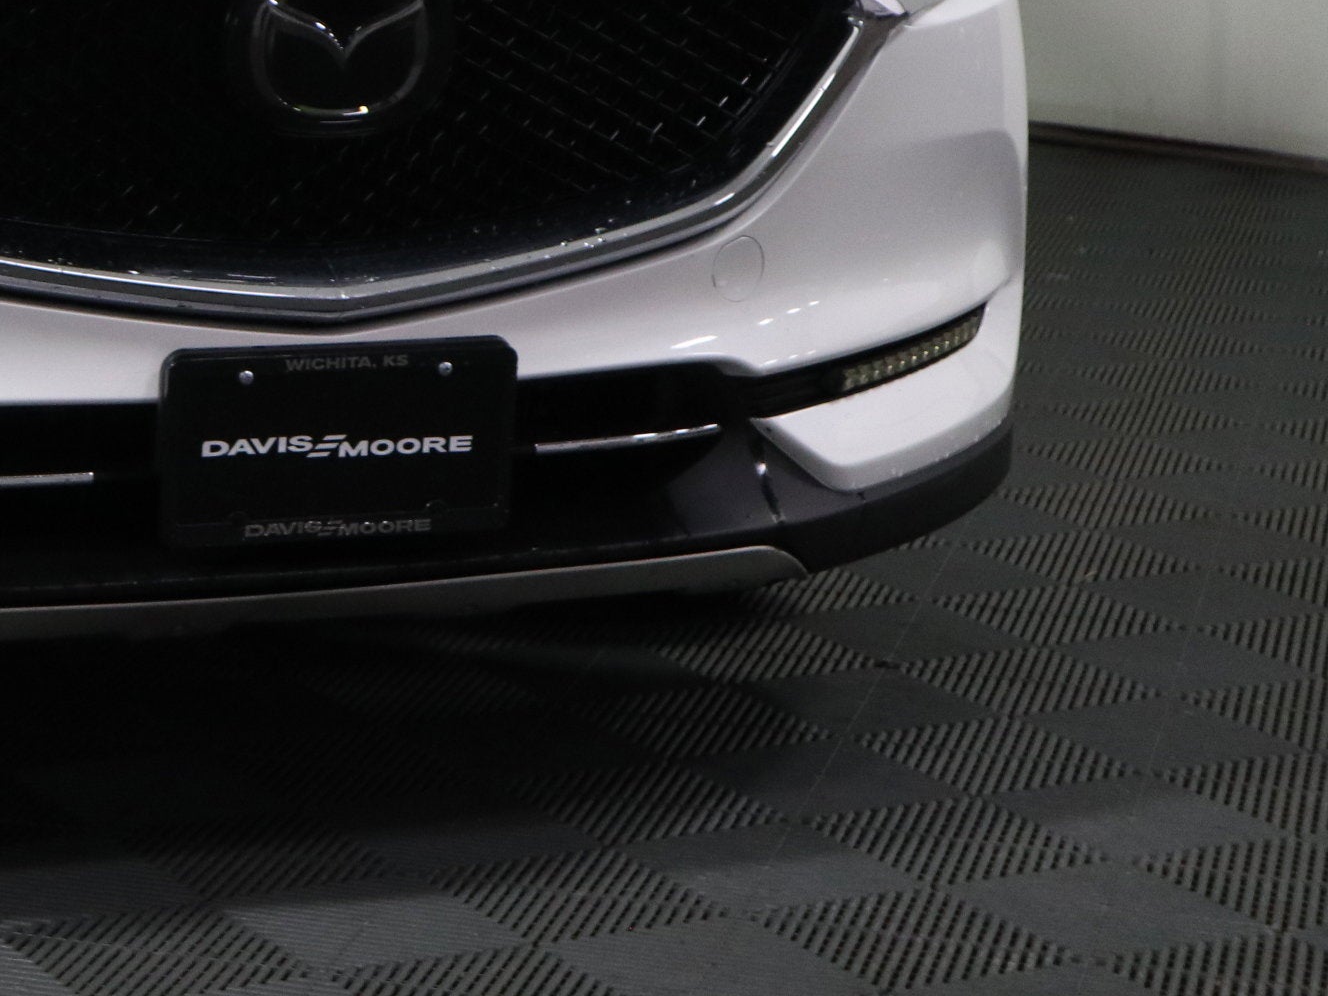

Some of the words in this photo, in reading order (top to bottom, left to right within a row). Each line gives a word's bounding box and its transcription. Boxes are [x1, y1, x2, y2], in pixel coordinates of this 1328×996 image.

[383, 354, 408, 367] KS
[201, 435, 313, 457] DAVIS
[338, 435, 473, 457] MOORE
[244, 520, 322, 538] DAVIS
[339, 518, 432, 536] MOORE
